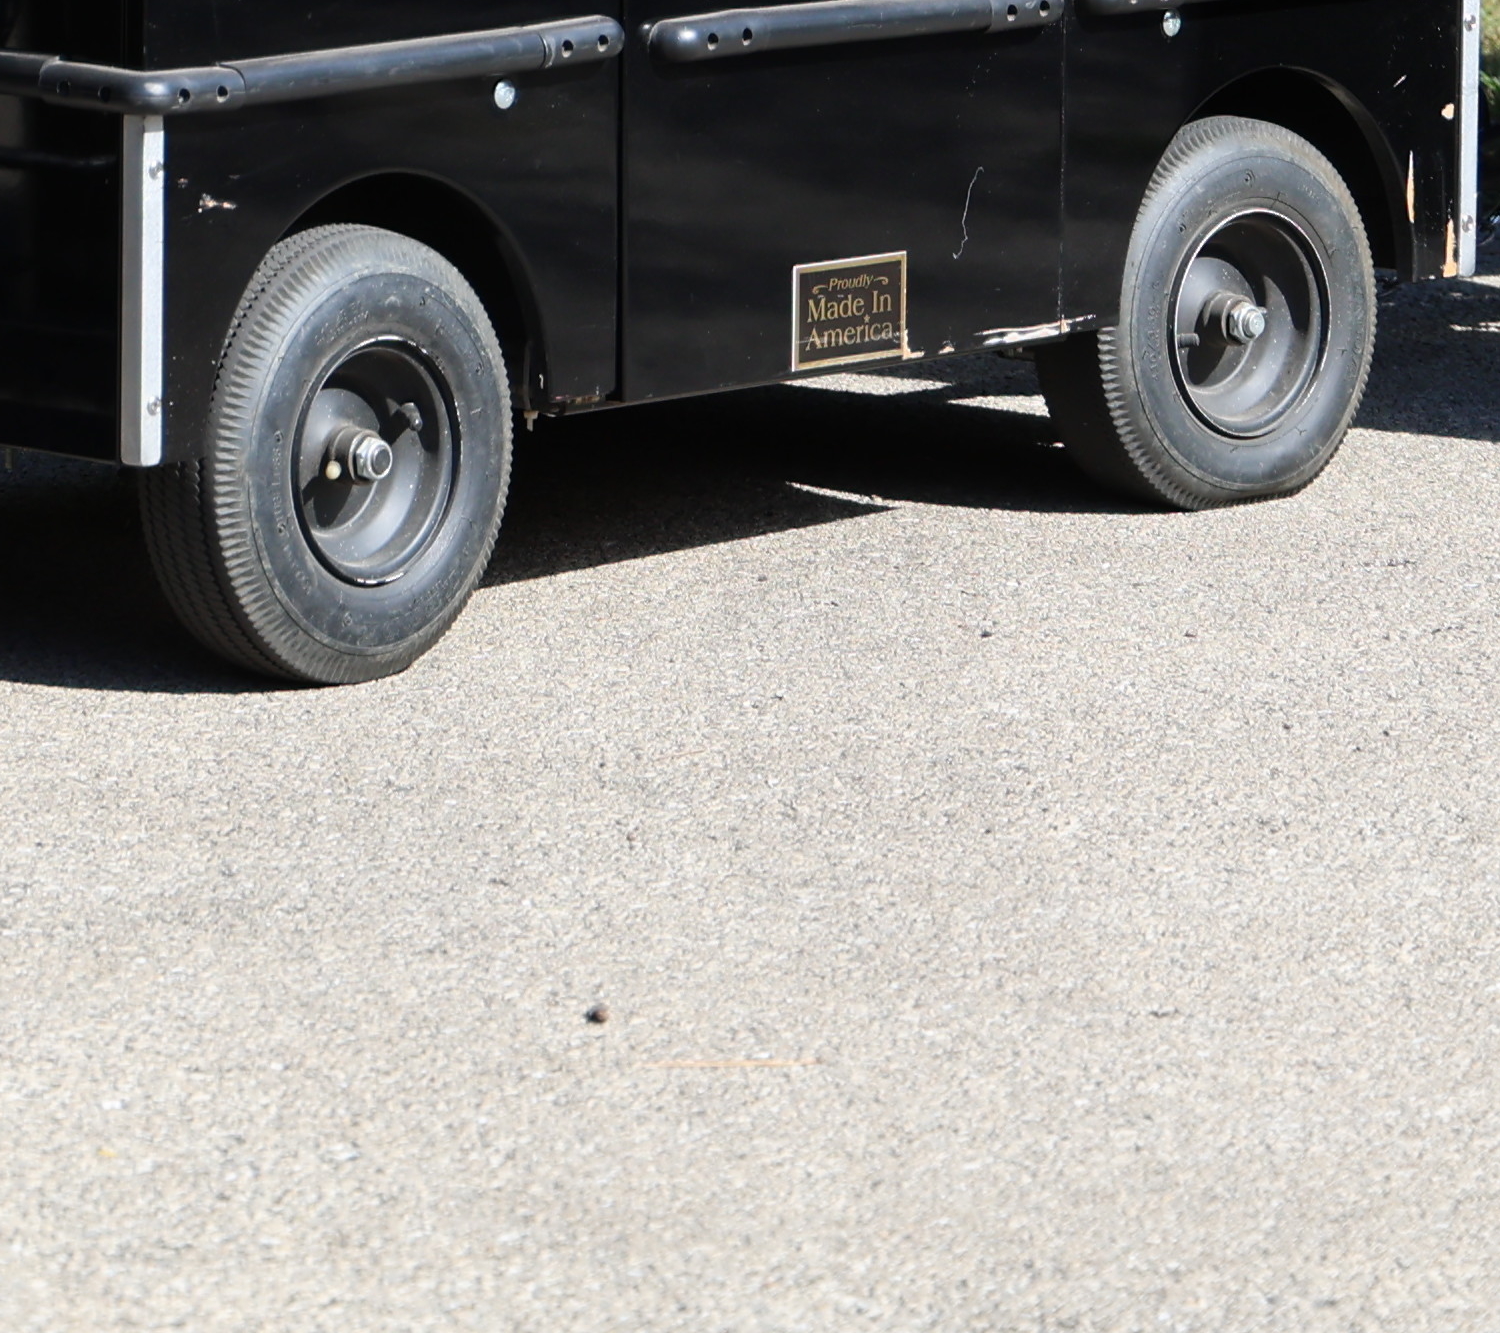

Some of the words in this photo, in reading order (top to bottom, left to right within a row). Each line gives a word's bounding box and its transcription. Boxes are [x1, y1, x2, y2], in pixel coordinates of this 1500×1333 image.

[828, 273, 874, 292] Proudly
[807, 294, 865, 323] Made
[872, 290, 892, 314] In
[805, 315, 894, 351] America
